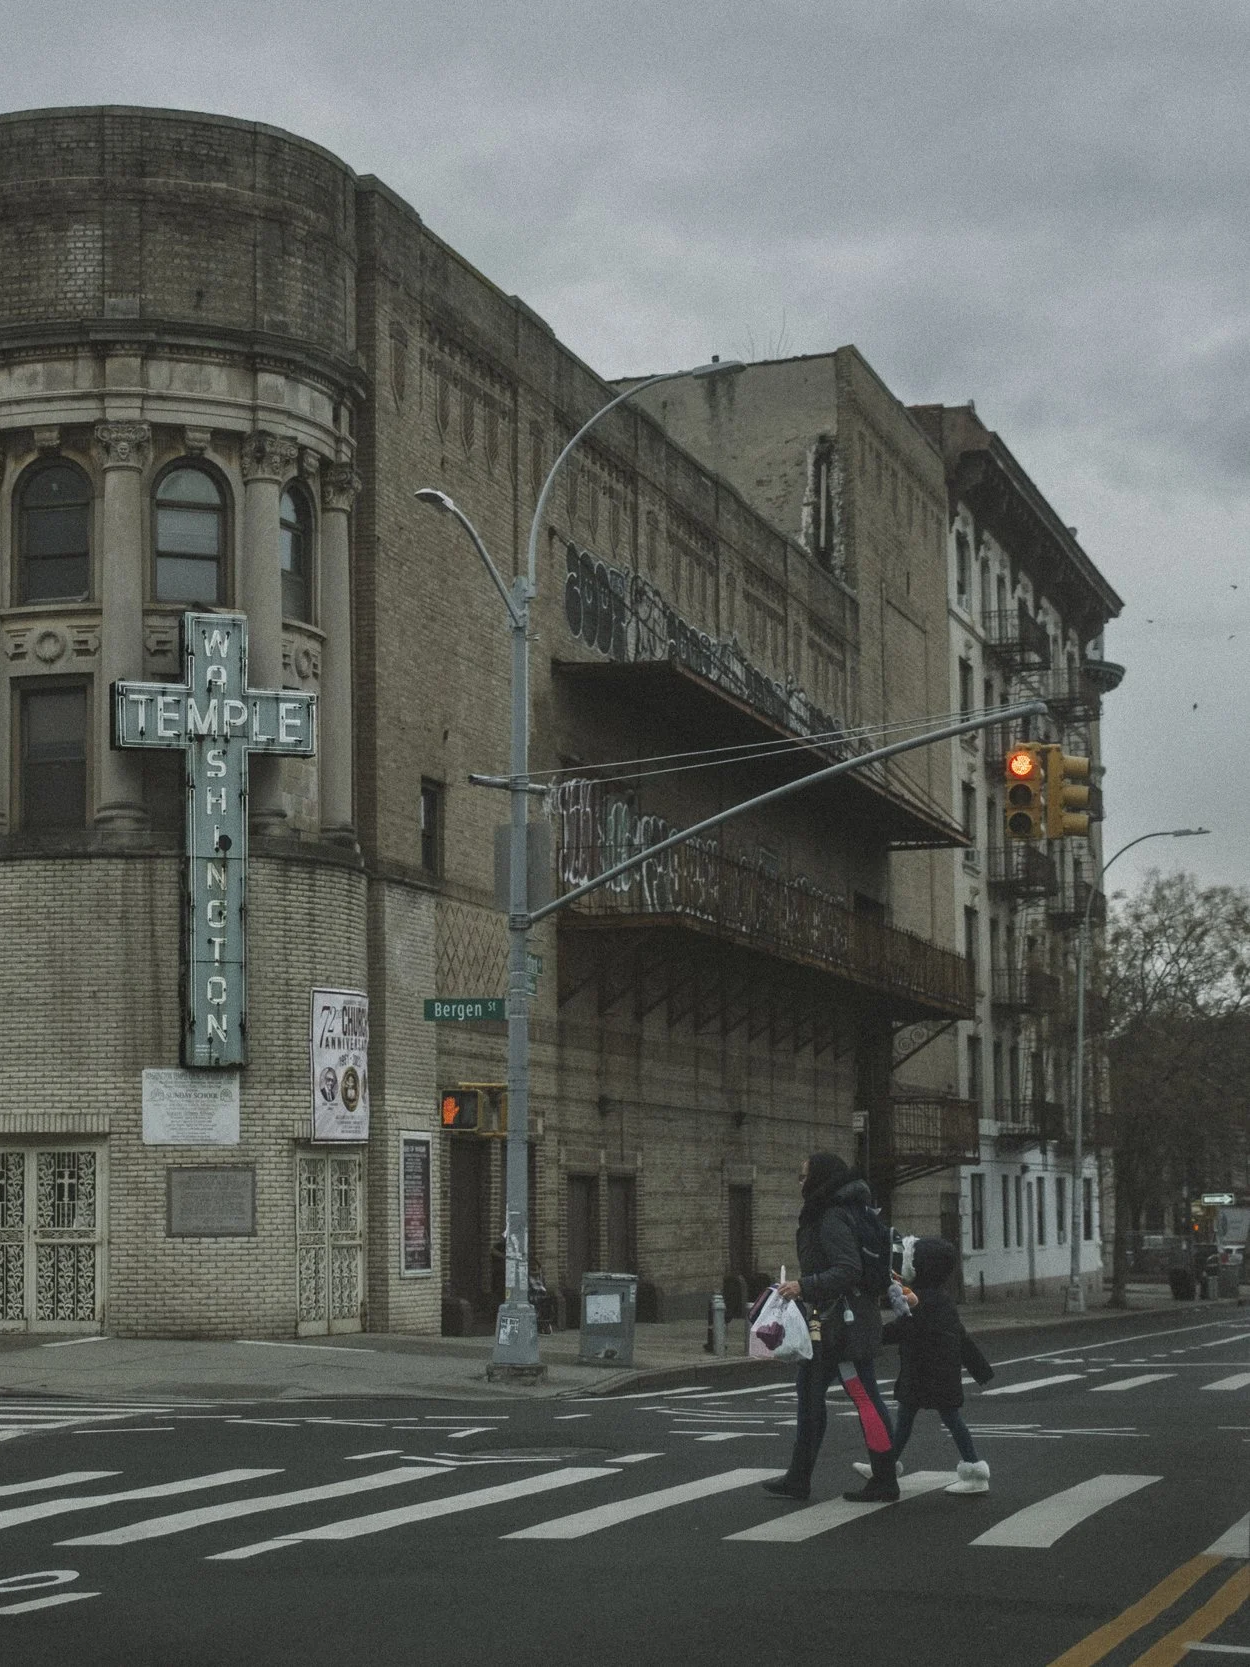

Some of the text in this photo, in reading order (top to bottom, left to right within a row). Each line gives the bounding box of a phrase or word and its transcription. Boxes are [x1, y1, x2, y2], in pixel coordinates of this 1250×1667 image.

[128, 694, 303, 744] TEMPLE
[203, 629, 231, 1043] WASHINGTON
[434, 1001, 497, 1021] Bergen St
